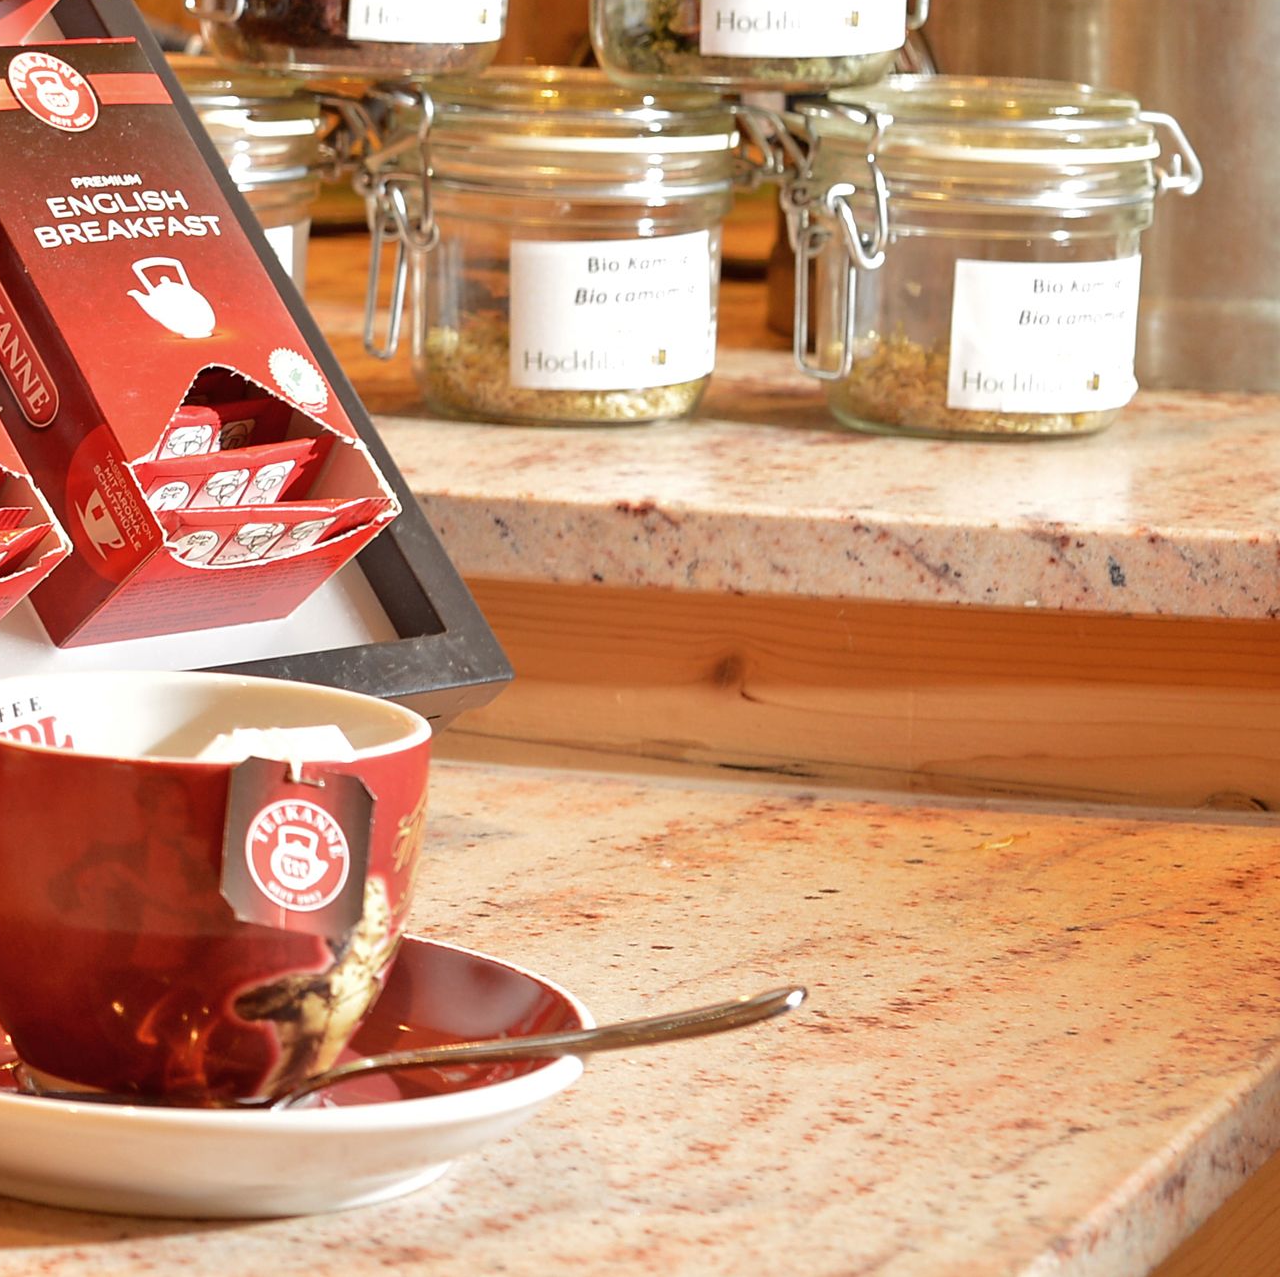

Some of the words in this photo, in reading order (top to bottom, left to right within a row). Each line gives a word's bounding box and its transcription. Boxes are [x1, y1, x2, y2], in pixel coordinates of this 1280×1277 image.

[70, 174, 142, 189] PREMIUM
[46, 190, 190, 219] ENGLISH
[34, 215, 221, 250] BREAKFAST
[588, 257, 620, 273] Bio
[574, 287, 608, 305] Bio
[1033, 278, 1064, 295] Bio
[1018, 309, 1051, 326] Bio
[104, 466, 119, 488] MIT
[107, 450, 154, 541] TASSENPORTION
[93, 464, 142, 551] SCHUTZHÜLLE
[248, 804, 345, 859] TEEKANNE
